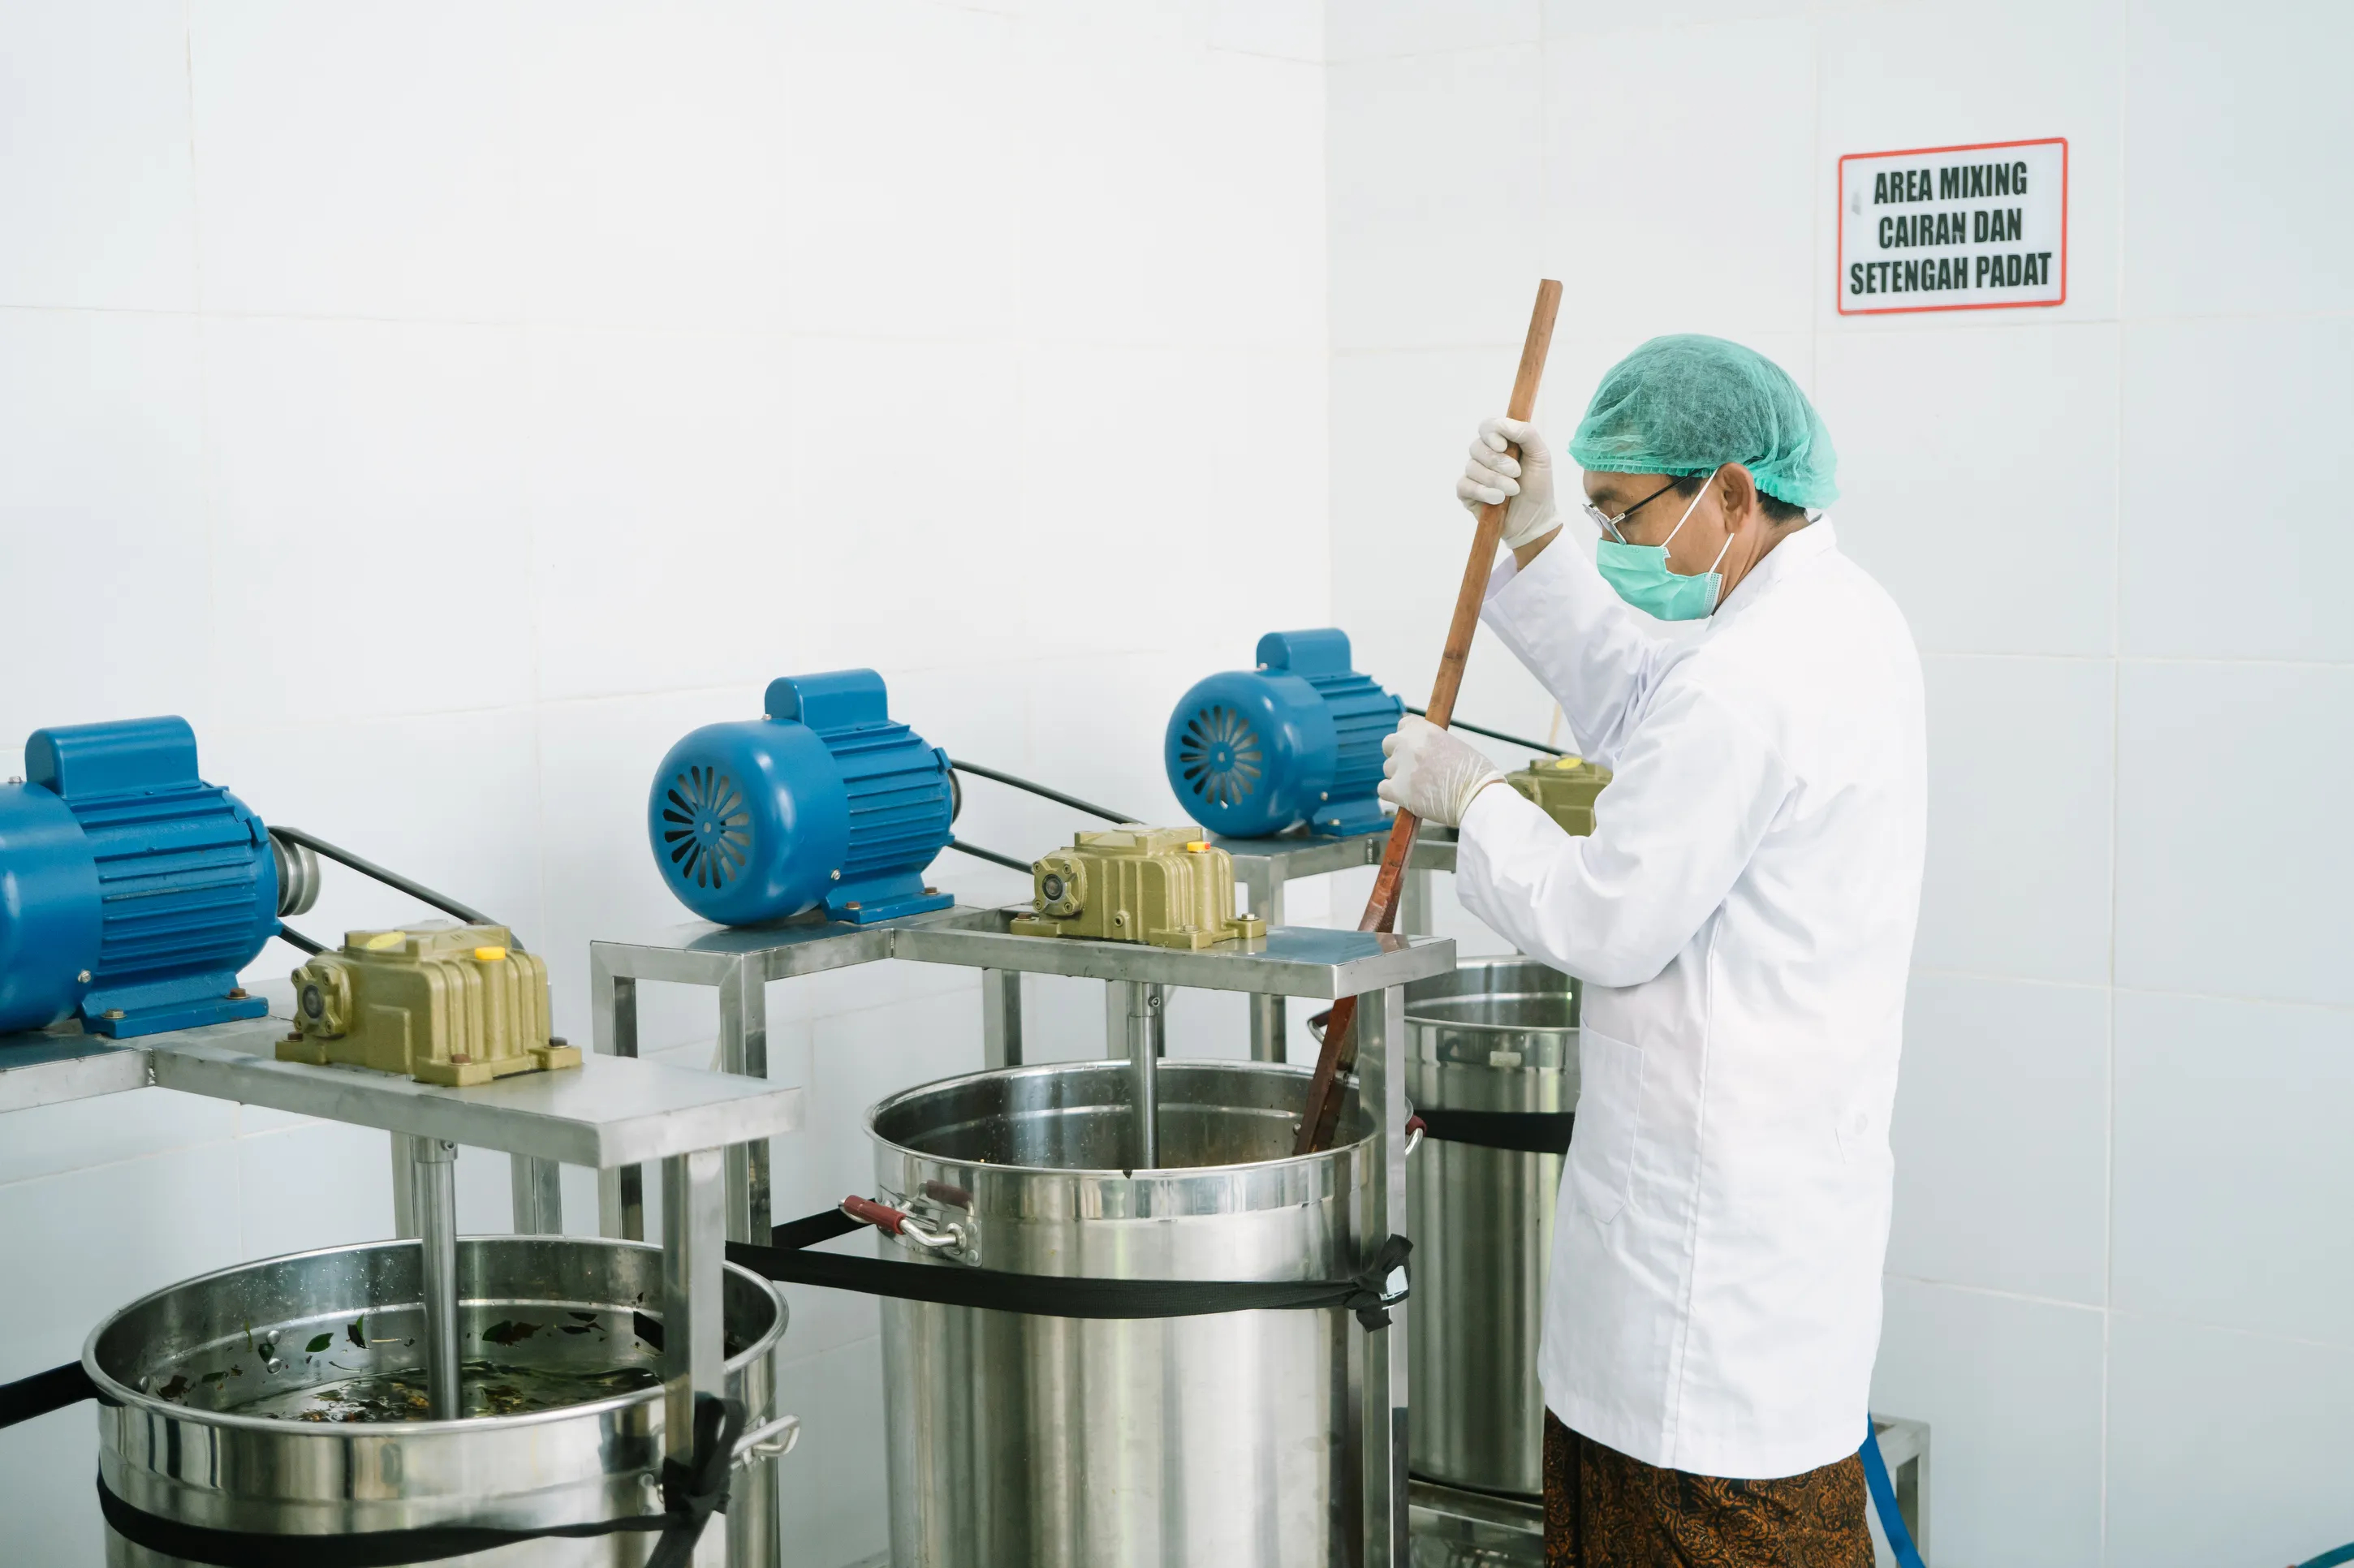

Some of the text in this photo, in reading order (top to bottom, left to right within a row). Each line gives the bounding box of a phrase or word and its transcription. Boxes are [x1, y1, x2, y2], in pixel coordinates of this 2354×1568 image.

[1873, 162, 2027, 205] AREA MIXING
[1879, 209, 2022, 249] CAIRAN DAN
[1851, 252, 2052, 295] SETENGAH PADAT
